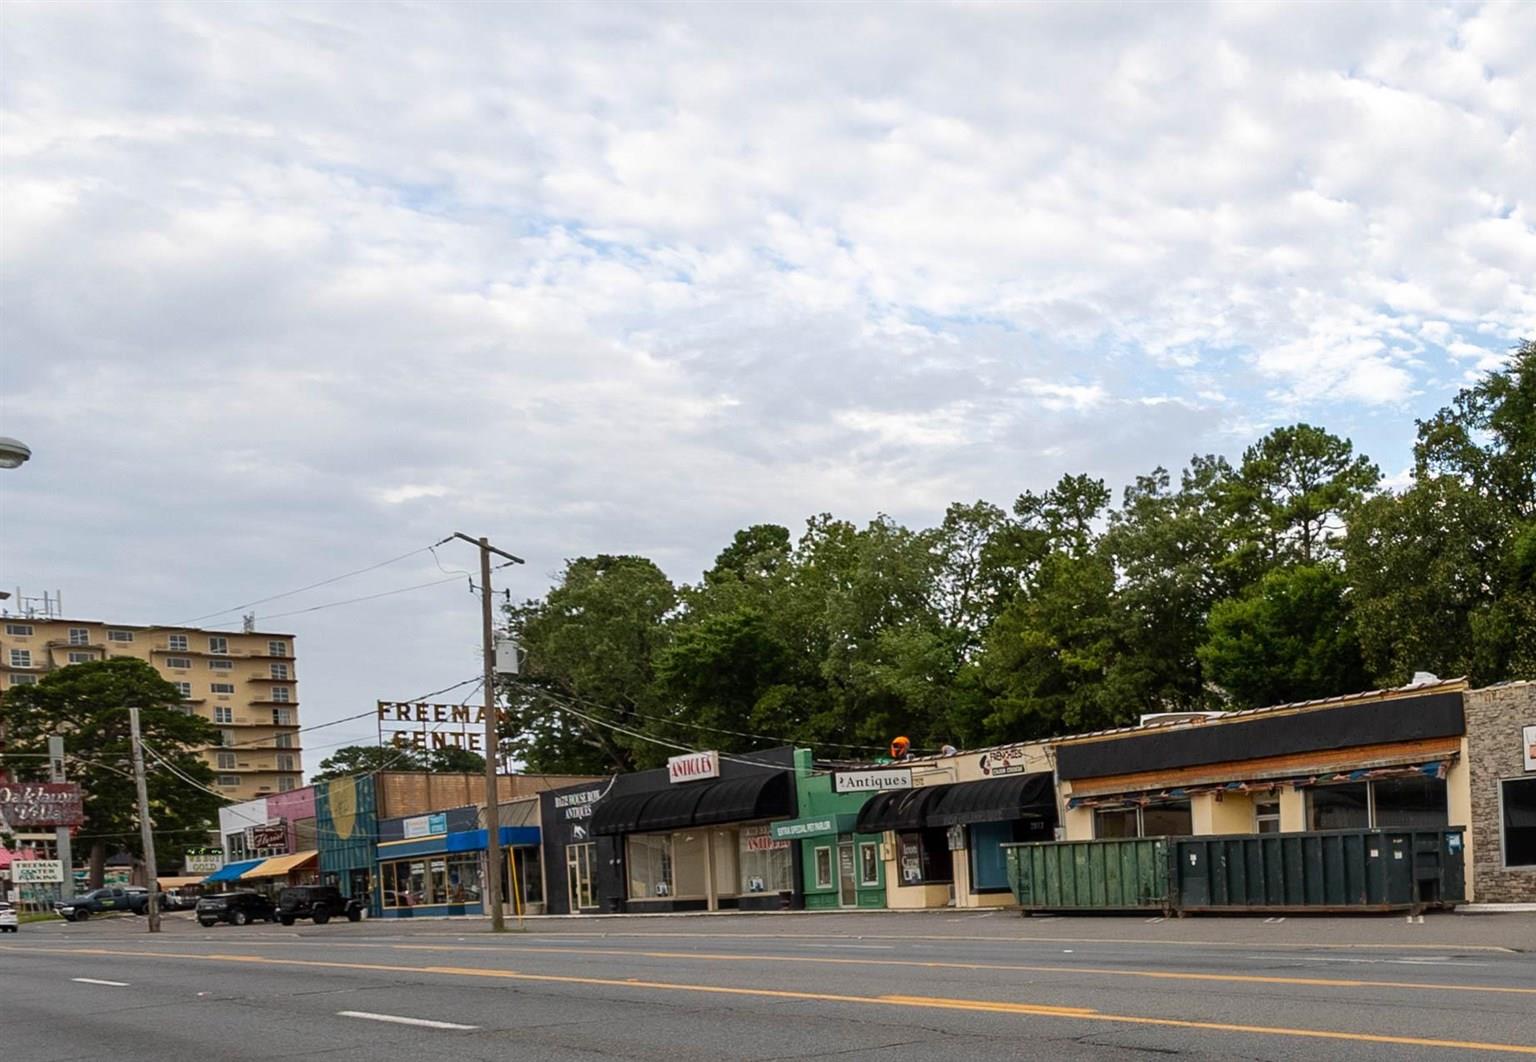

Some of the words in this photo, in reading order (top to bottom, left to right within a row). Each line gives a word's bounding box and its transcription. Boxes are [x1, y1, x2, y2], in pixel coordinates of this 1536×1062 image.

[379, 702, 509, 724] FREEMAN
[392, 731, 487, 751] CENTE
[672, 757, 712, 777] ANTIQUES
[847, 775, 907, 789] Antiques
[193, 863, 217, 871] GOLD
